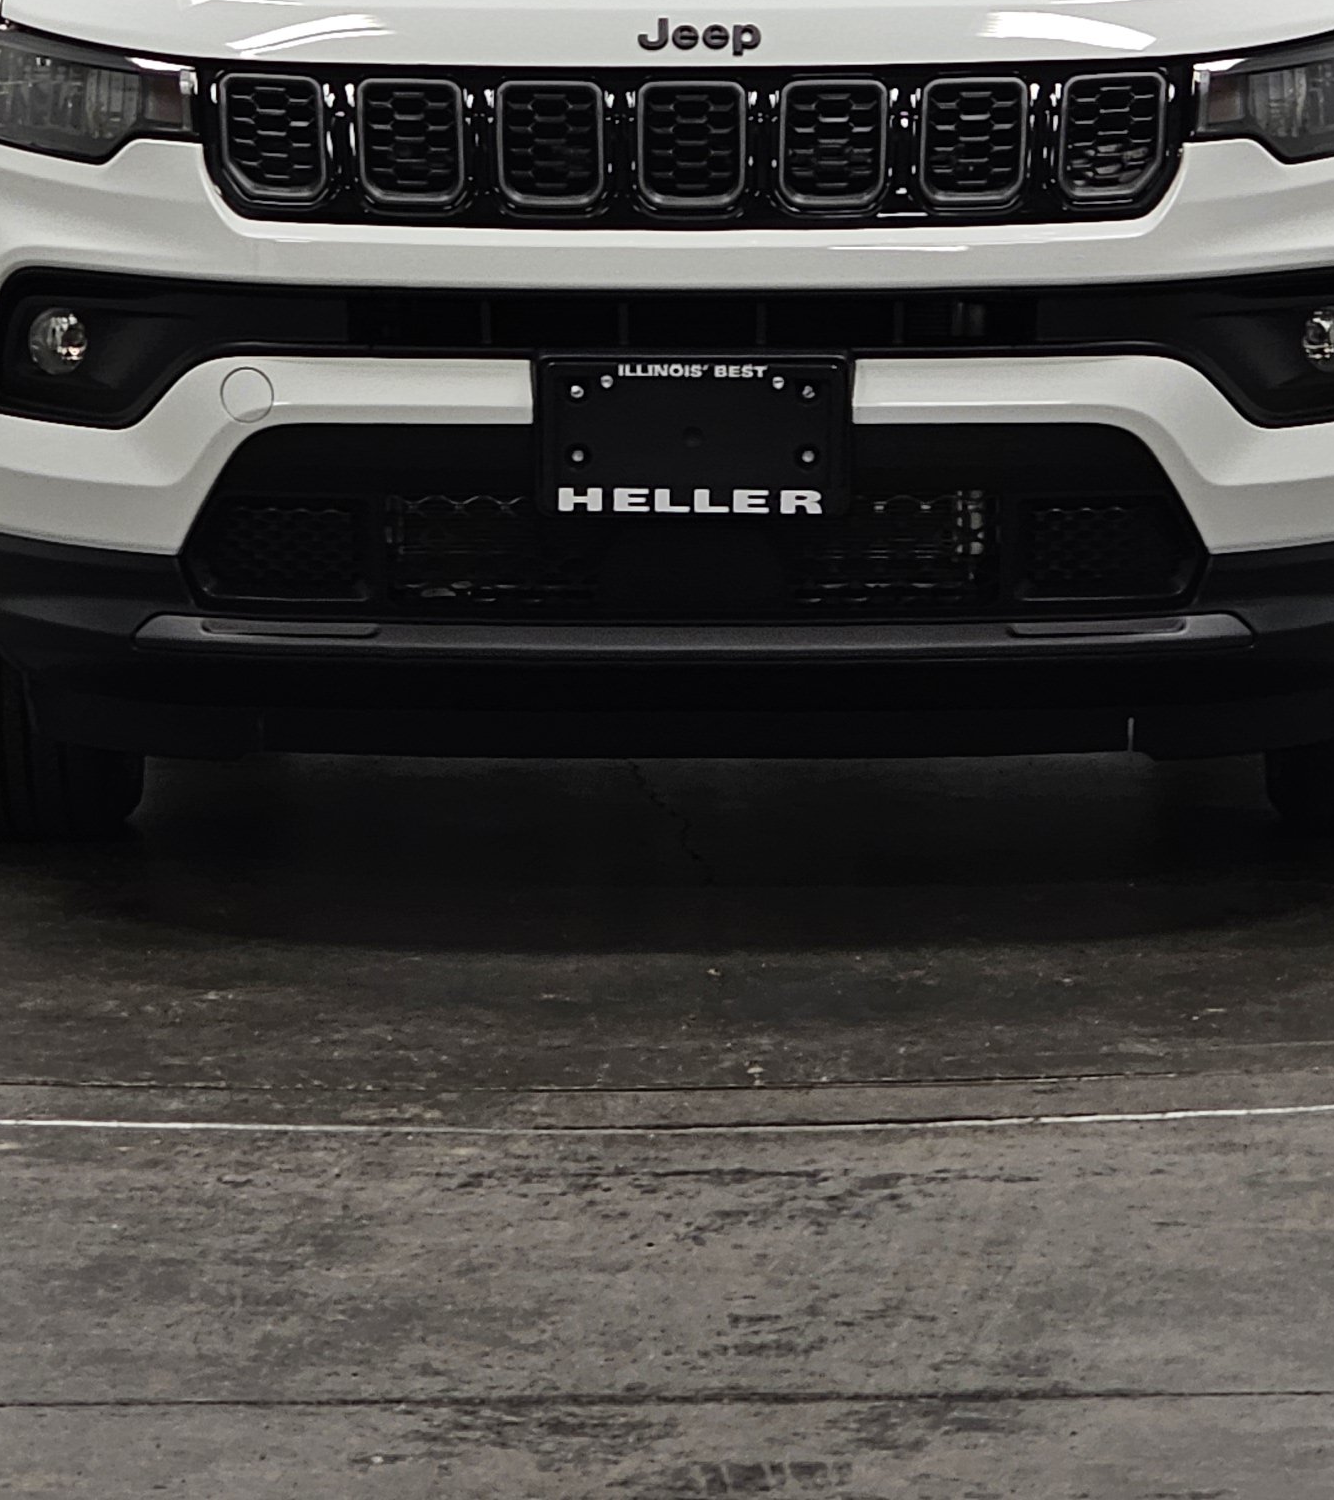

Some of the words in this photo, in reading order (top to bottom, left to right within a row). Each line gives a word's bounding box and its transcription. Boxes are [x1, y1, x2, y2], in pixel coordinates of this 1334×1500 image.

[637, 17, 762, 56] Jeep
[713, 364, 768, 378] BEST
[557, 487, 823, 515] HELLER
